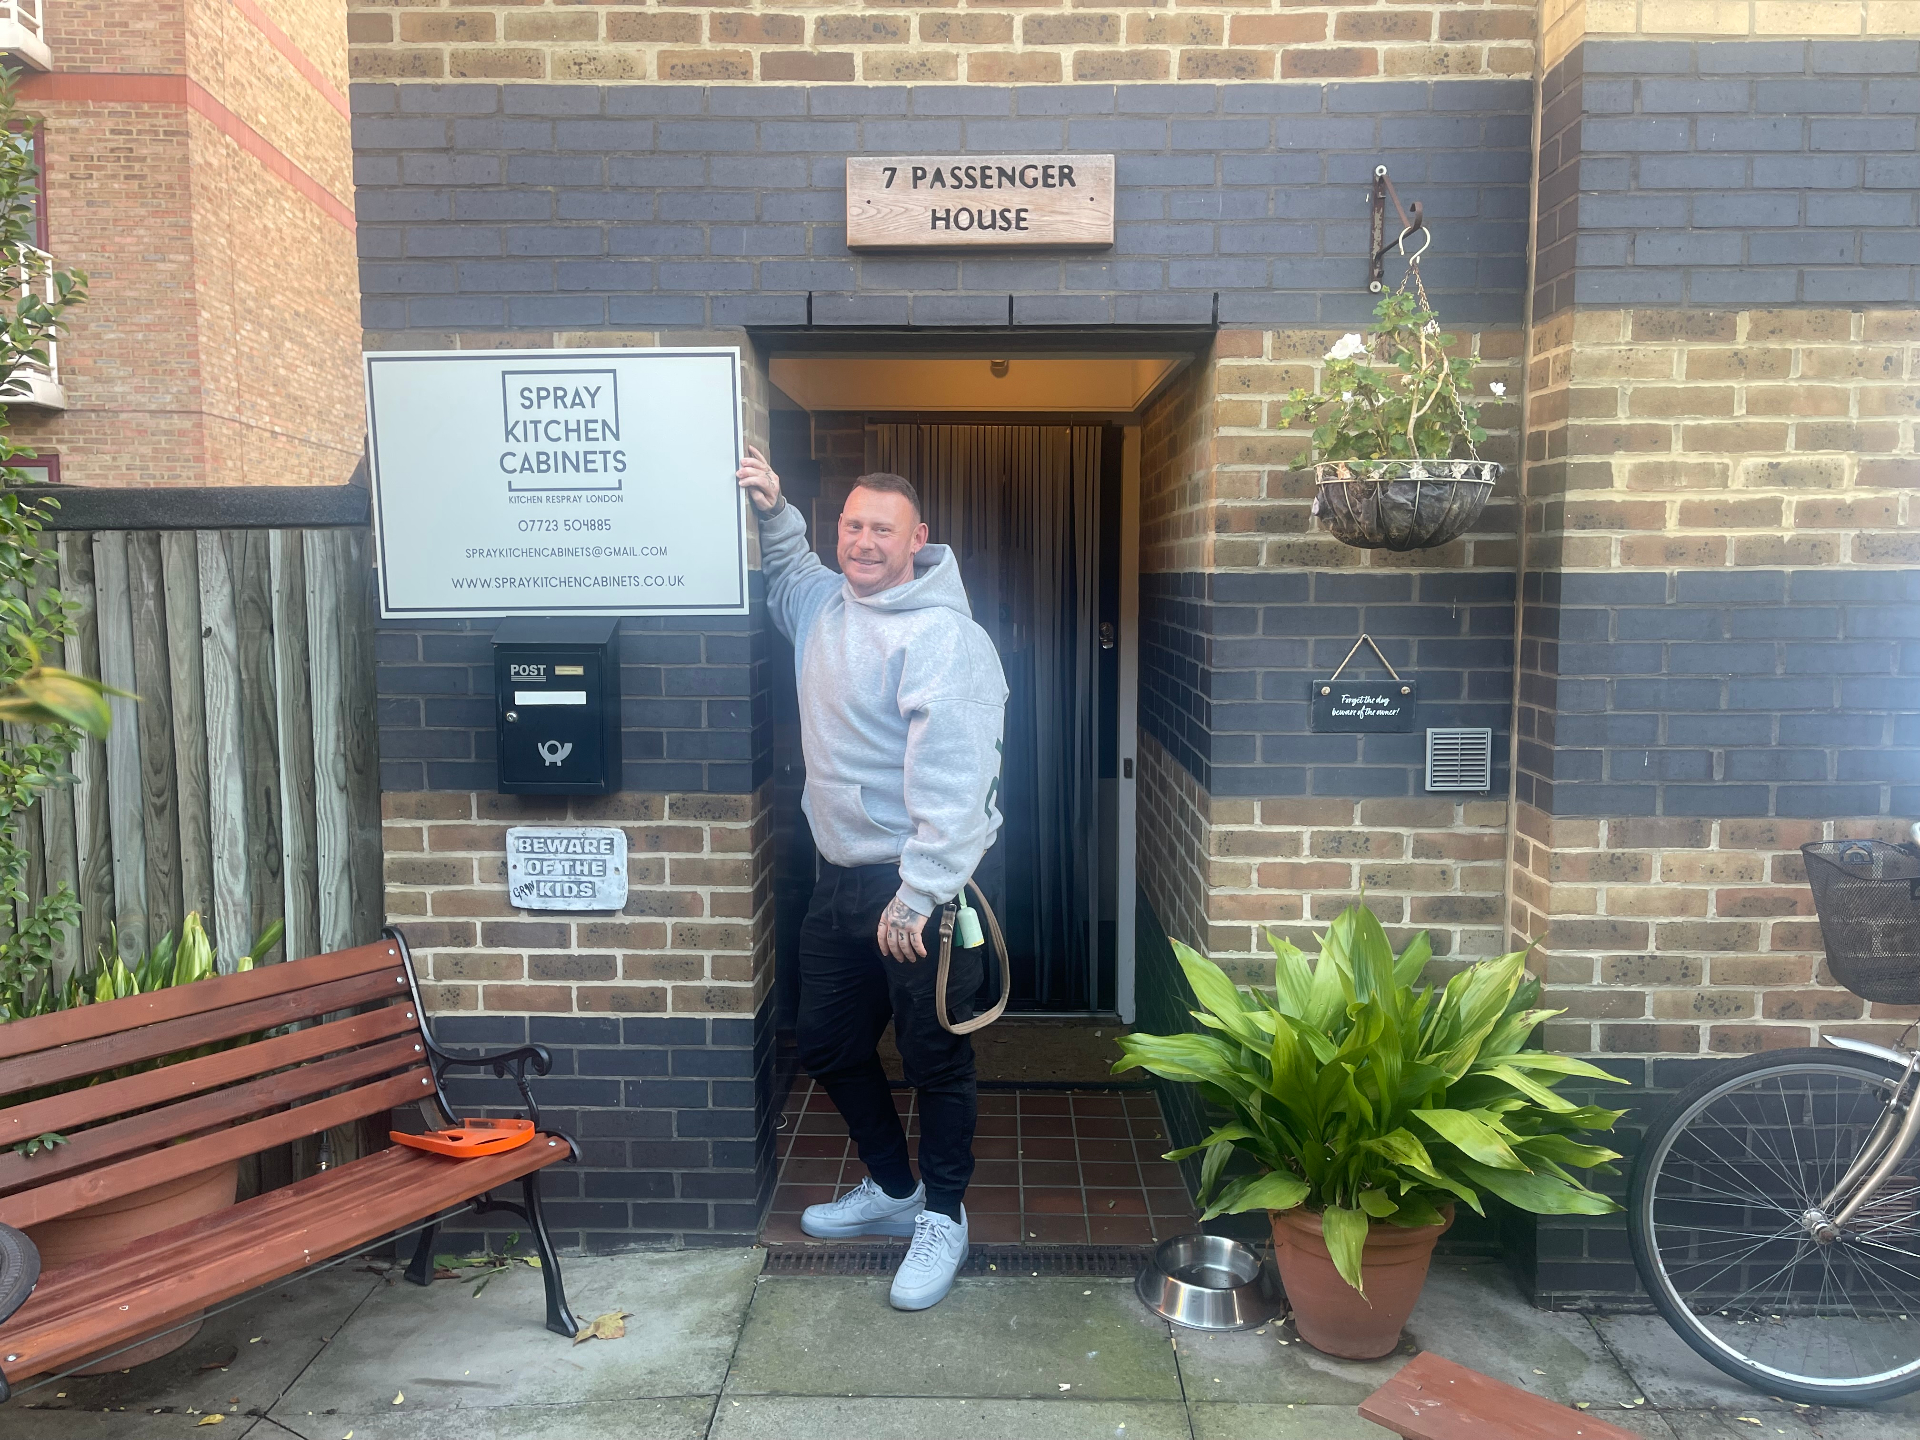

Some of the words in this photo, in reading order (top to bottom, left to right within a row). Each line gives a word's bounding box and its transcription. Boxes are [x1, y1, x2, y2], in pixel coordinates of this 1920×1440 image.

[882, 166, 898, 189] 7
[911, 164, 1076, 190] PASSENGER
[931, 207, 1029, 232] HOUSE
[519, 386, 602, 410] SPRAY
[504, 419, 620, 443] KITCHEN
[499, 450, 627, 475] CABINETS
[508, 495, 543, 504] KITCHEN
[545, 494, 583, 504] RESPRAY
[585, 494, 624, 504] LONDON
[518, 519, 559, 532] 07723
[563, 519, 612, 532] 504885
[465, 546, 668, 559] SPRAYKITCHENCABINETS@GMAIL.COM
[451, 574, 686, 589] WWW.SPRAYKITCHENCABINETS.CO.UK
[510, 664, 547, 676] POST
[1341, 694, 1363, 706] Forget
[1364, 696, 1376, 704] the
[1376, 695, 1390, 706] dog
[1331, 707, 1356, 716] beware
[1357, 705, 1366, 719] of
[1365, 708, 1375, 716] the
[1376, 708, 1401, 716] owner!
[517, 837, 612, 854] BEWARE
[526, 859, 555, 875] OF
[560, 859, 604, 875] THE
[538, 881, 595, 898] KIDS
